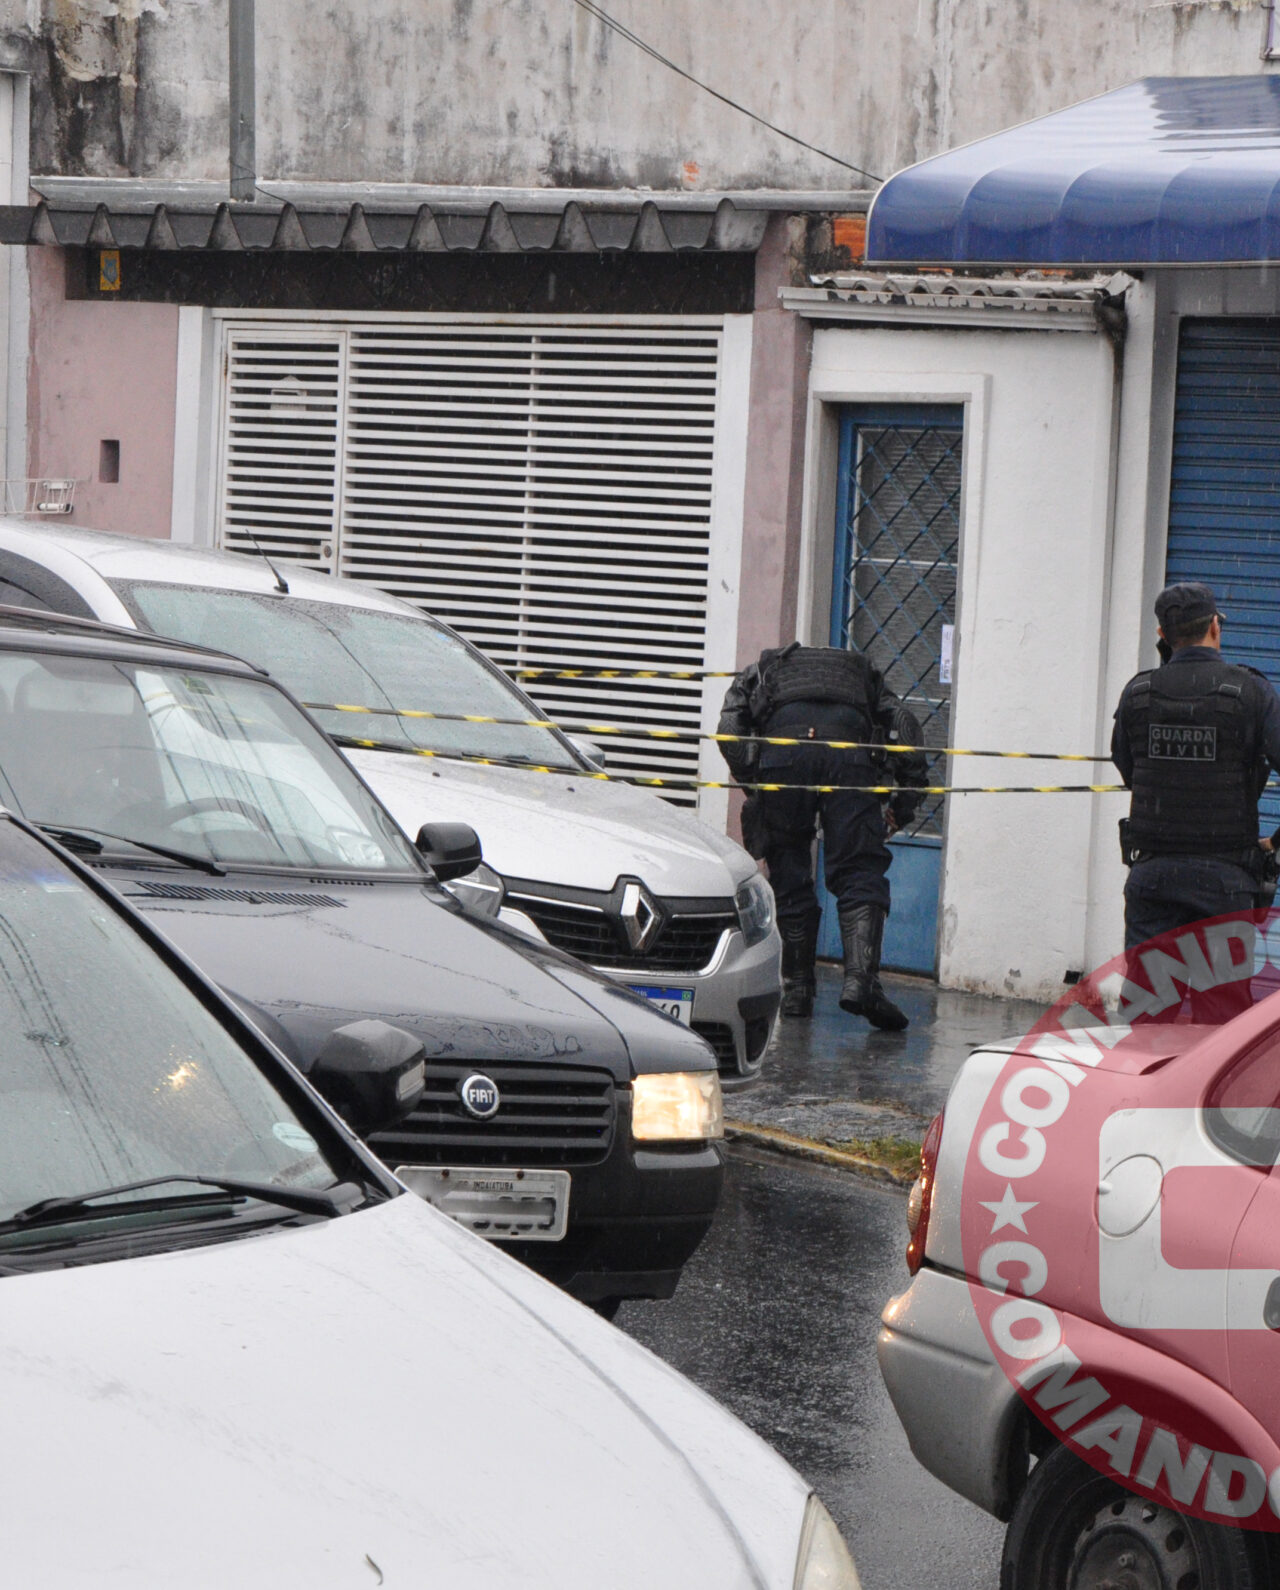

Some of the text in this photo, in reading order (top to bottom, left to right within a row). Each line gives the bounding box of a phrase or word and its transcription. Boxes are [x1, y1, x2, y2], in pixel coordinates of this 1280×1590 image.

[1152, 728, 1213, 742] GUARDA
[1152, 743, 1212, 757] CIVIL
[469, 1089, 494, 1103] FIAT
